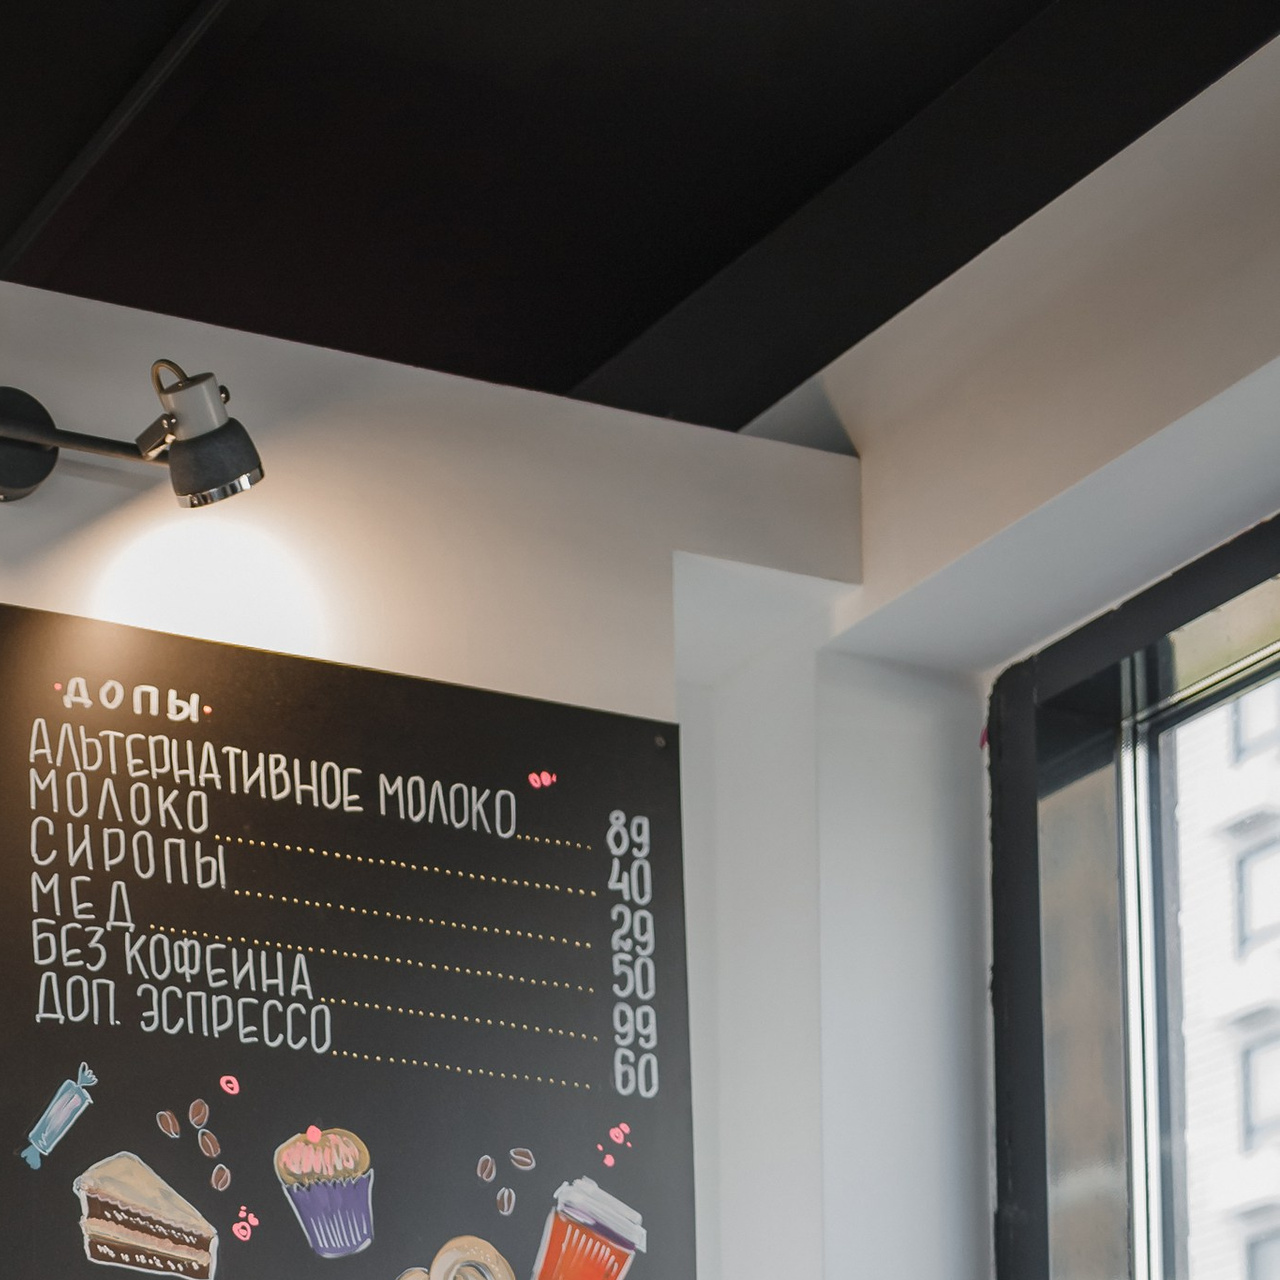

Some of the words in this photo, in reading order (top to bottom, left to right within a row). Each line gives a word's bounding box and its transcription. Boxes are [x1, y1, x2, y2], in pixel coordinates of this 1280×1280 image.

[62, 677, 200, 722] ДОПЫ
[29, 718, 364, 813] АЛЬТЕРНАТИВНОЕ
[378, 773, 516, 839] МОЛОКО
[606, 810, 650, 858] 89
[29, 768, 209, 834] МОЛОКО
[607, 857, 652, 906] 40
[30, 816, 227, 889] СИРОПЫ
[610, 903, 656, 957] 29
[31, 871, 135, 932] МЕД
[612, 953, 656, 1001] 50
[32, 918, 107, 972] БЕЗ
[124, 931, 314, 1000] КОФЕИНА
[612, 1002, 658, 1050] 99
[136, 983, 332, 1053] ЭСПРЕССО
[613, 1048, 660, 1098] 60
